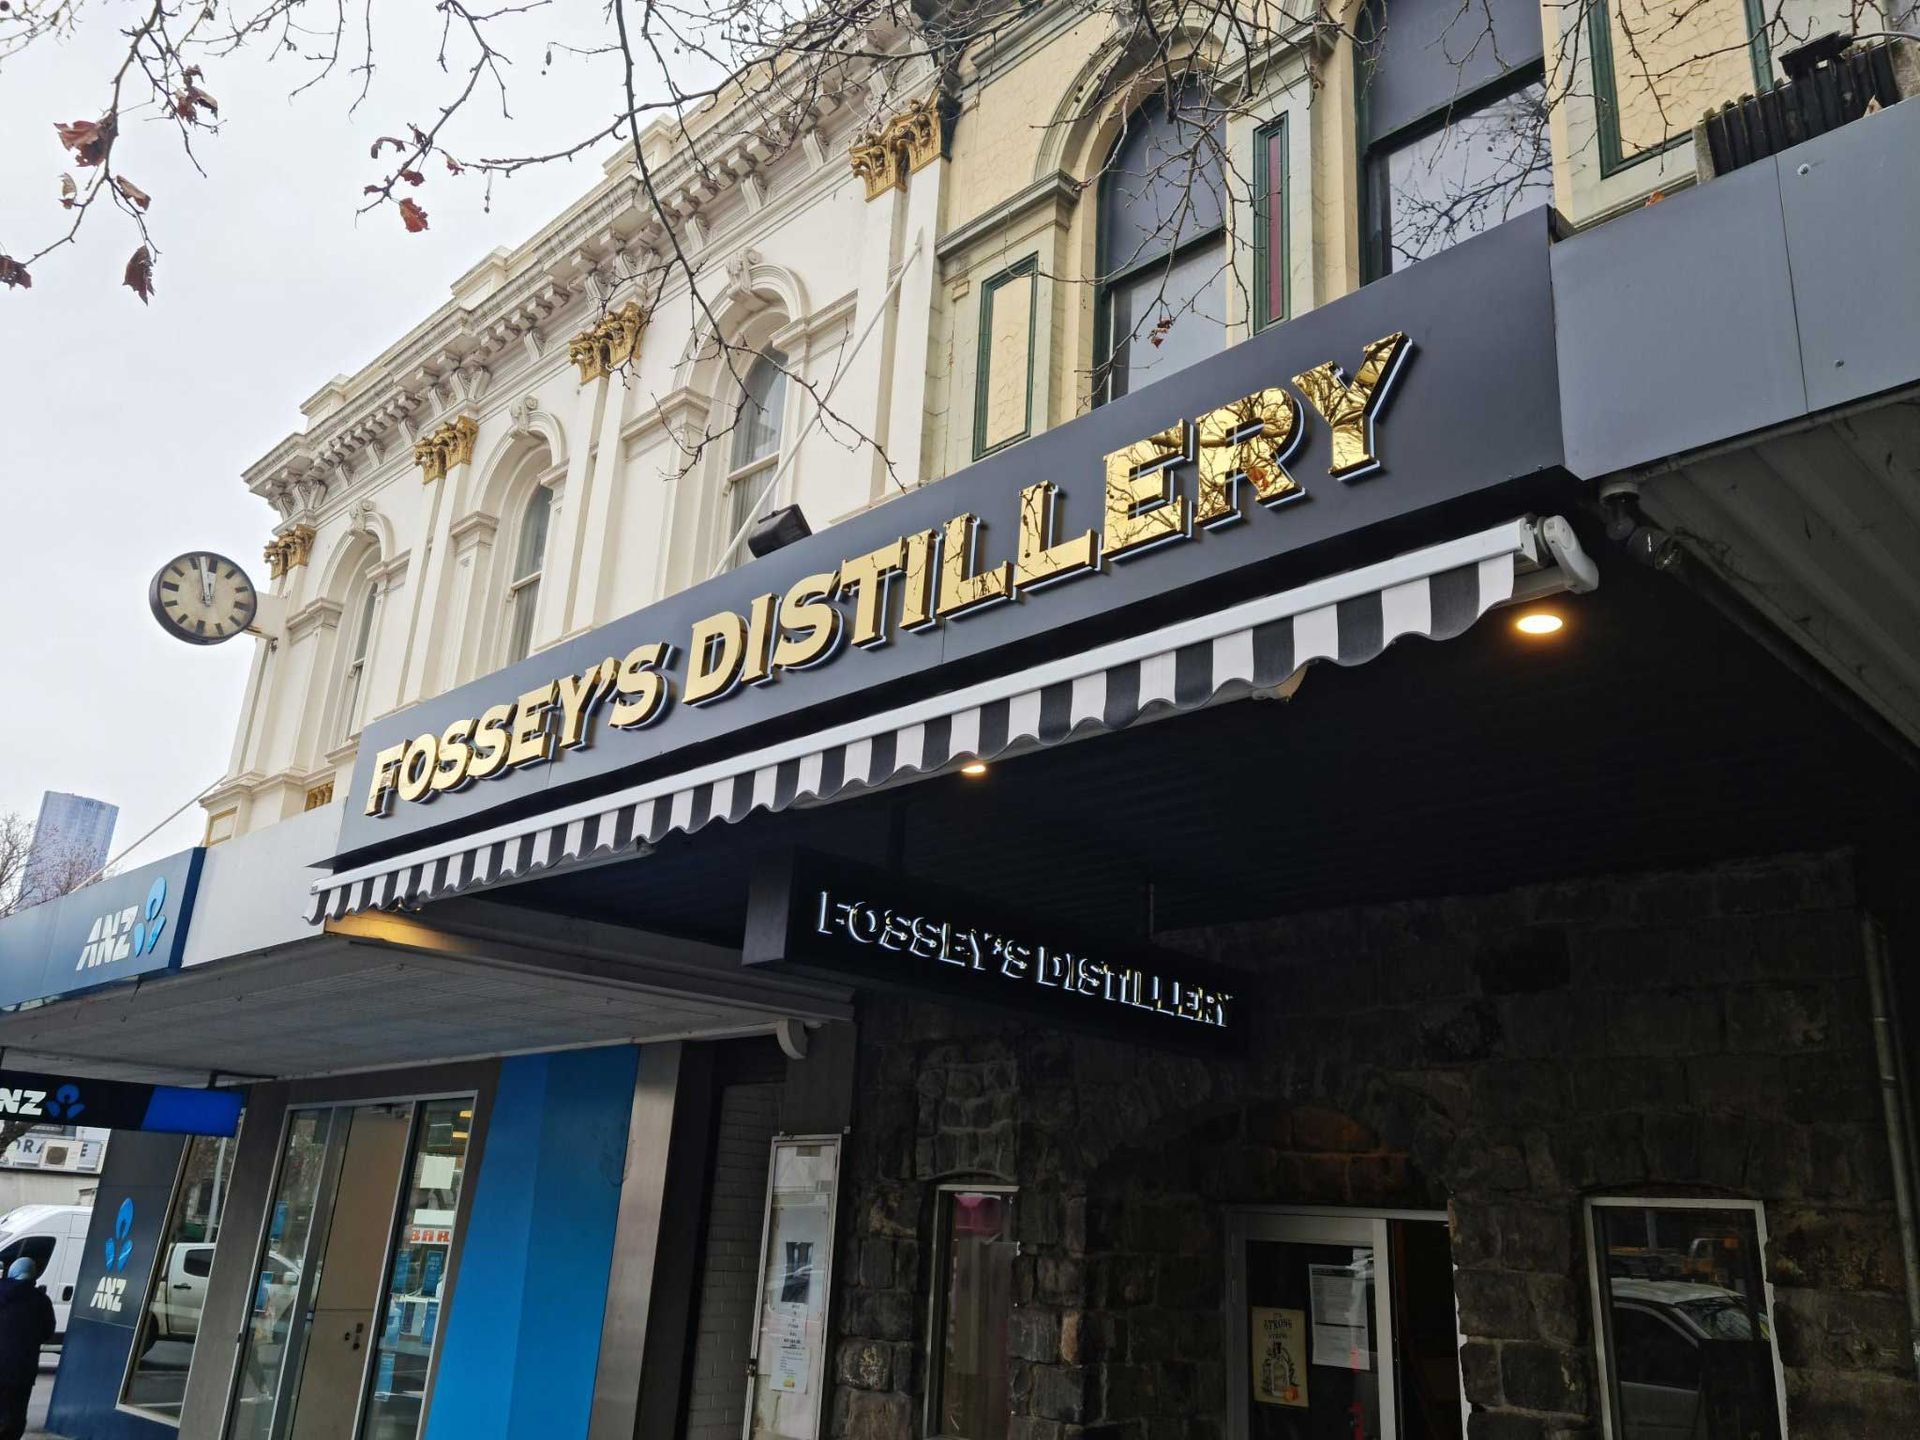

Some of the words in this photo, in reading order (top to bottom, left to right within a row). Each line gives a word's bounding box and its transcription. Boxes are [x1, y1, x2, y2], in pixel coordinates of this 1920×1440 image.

[363, 641, 675, 818] FOSSEY'S
[680, 331, 1415, 707] DISTILLERY
[75, 904, 140, 972] ANZ
[816, 890, 1031, 979] FOSSEY'S
[0, 1087, 47, 1116] NZ
[90, 1275, 127, 1312] ANZ
